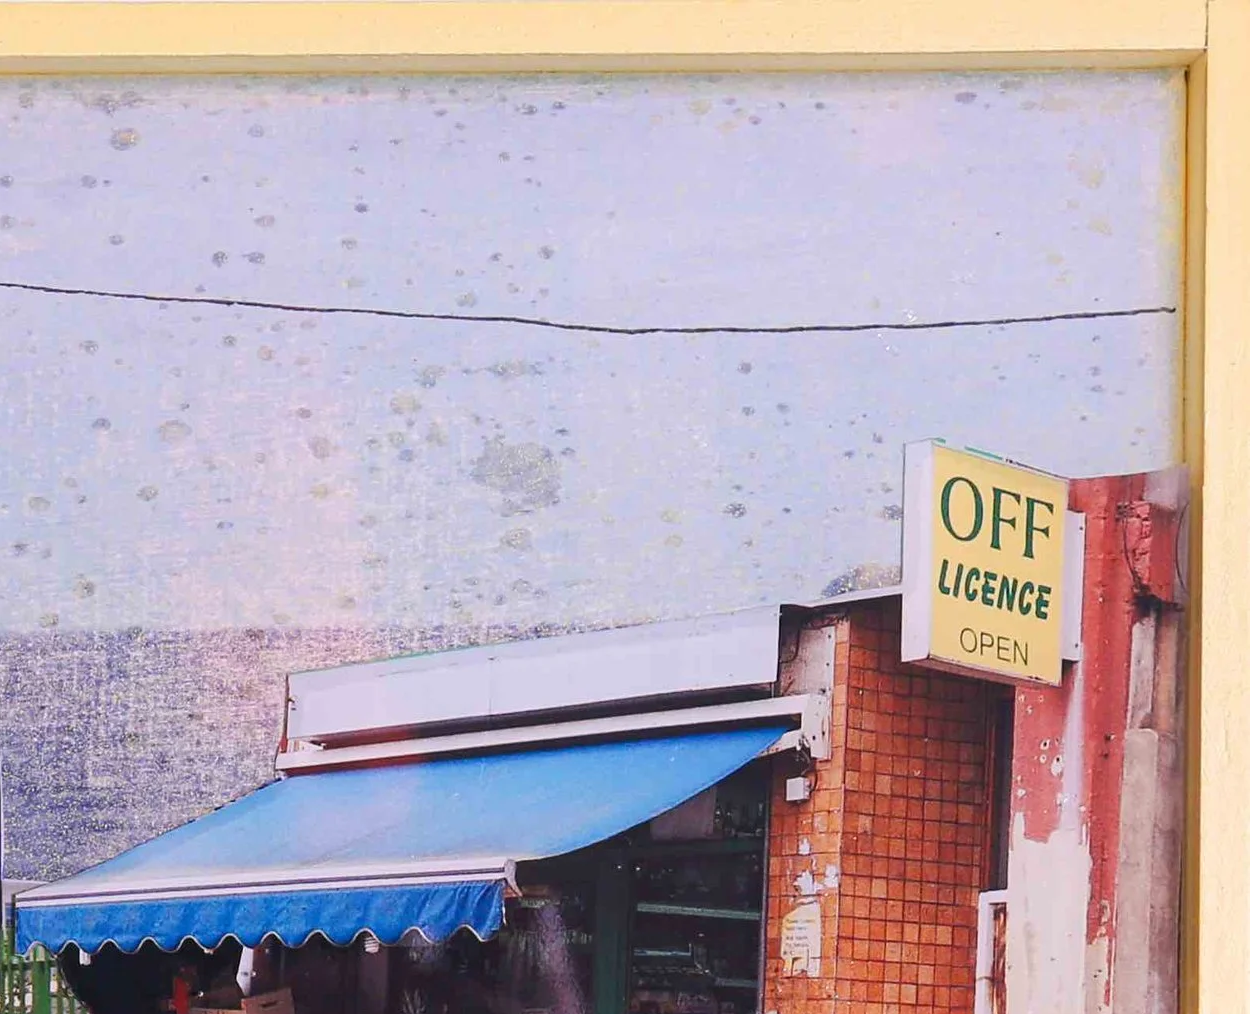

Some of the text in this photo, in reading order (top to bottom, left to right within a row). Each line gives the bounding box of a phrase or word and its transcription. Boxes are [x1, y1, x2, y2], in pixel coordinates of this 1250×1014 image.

[940, 475, 1055, 560] OFF
[938, 558, 1053, 621] LICENCE
[959, 627, 1029, 667] OPEN
